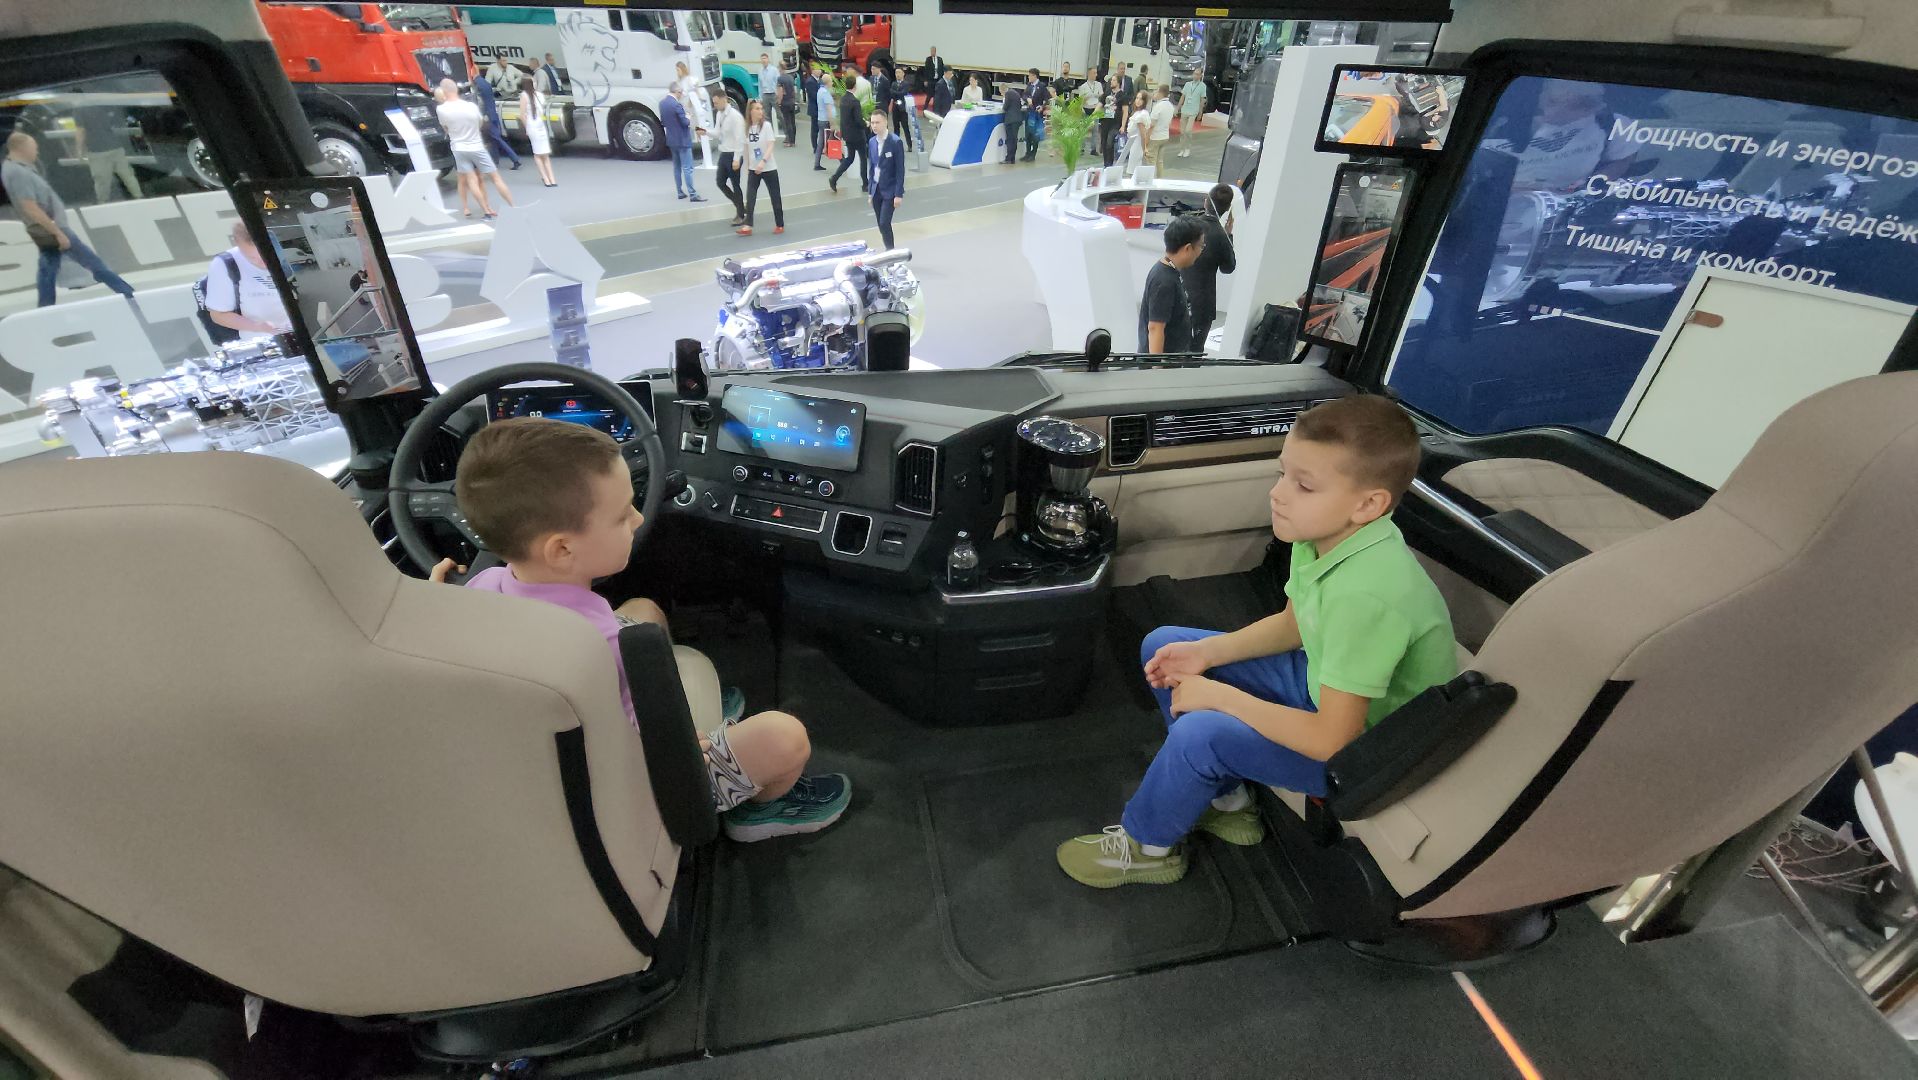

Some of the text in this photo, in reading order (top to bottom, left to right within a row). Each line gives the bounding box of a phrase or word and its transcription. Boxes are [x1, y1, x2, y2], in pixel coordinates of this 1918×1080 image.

[1607, 118, 1760, 155] Мощность
[1765, 139, 1790, 159] и
[1586, 174, 1784, 219] Стабильность
[1790, 205, 1810, 224] и
[1566, 224, 1667, 260] Тишина
[1671, 245, 1692, 264] и
